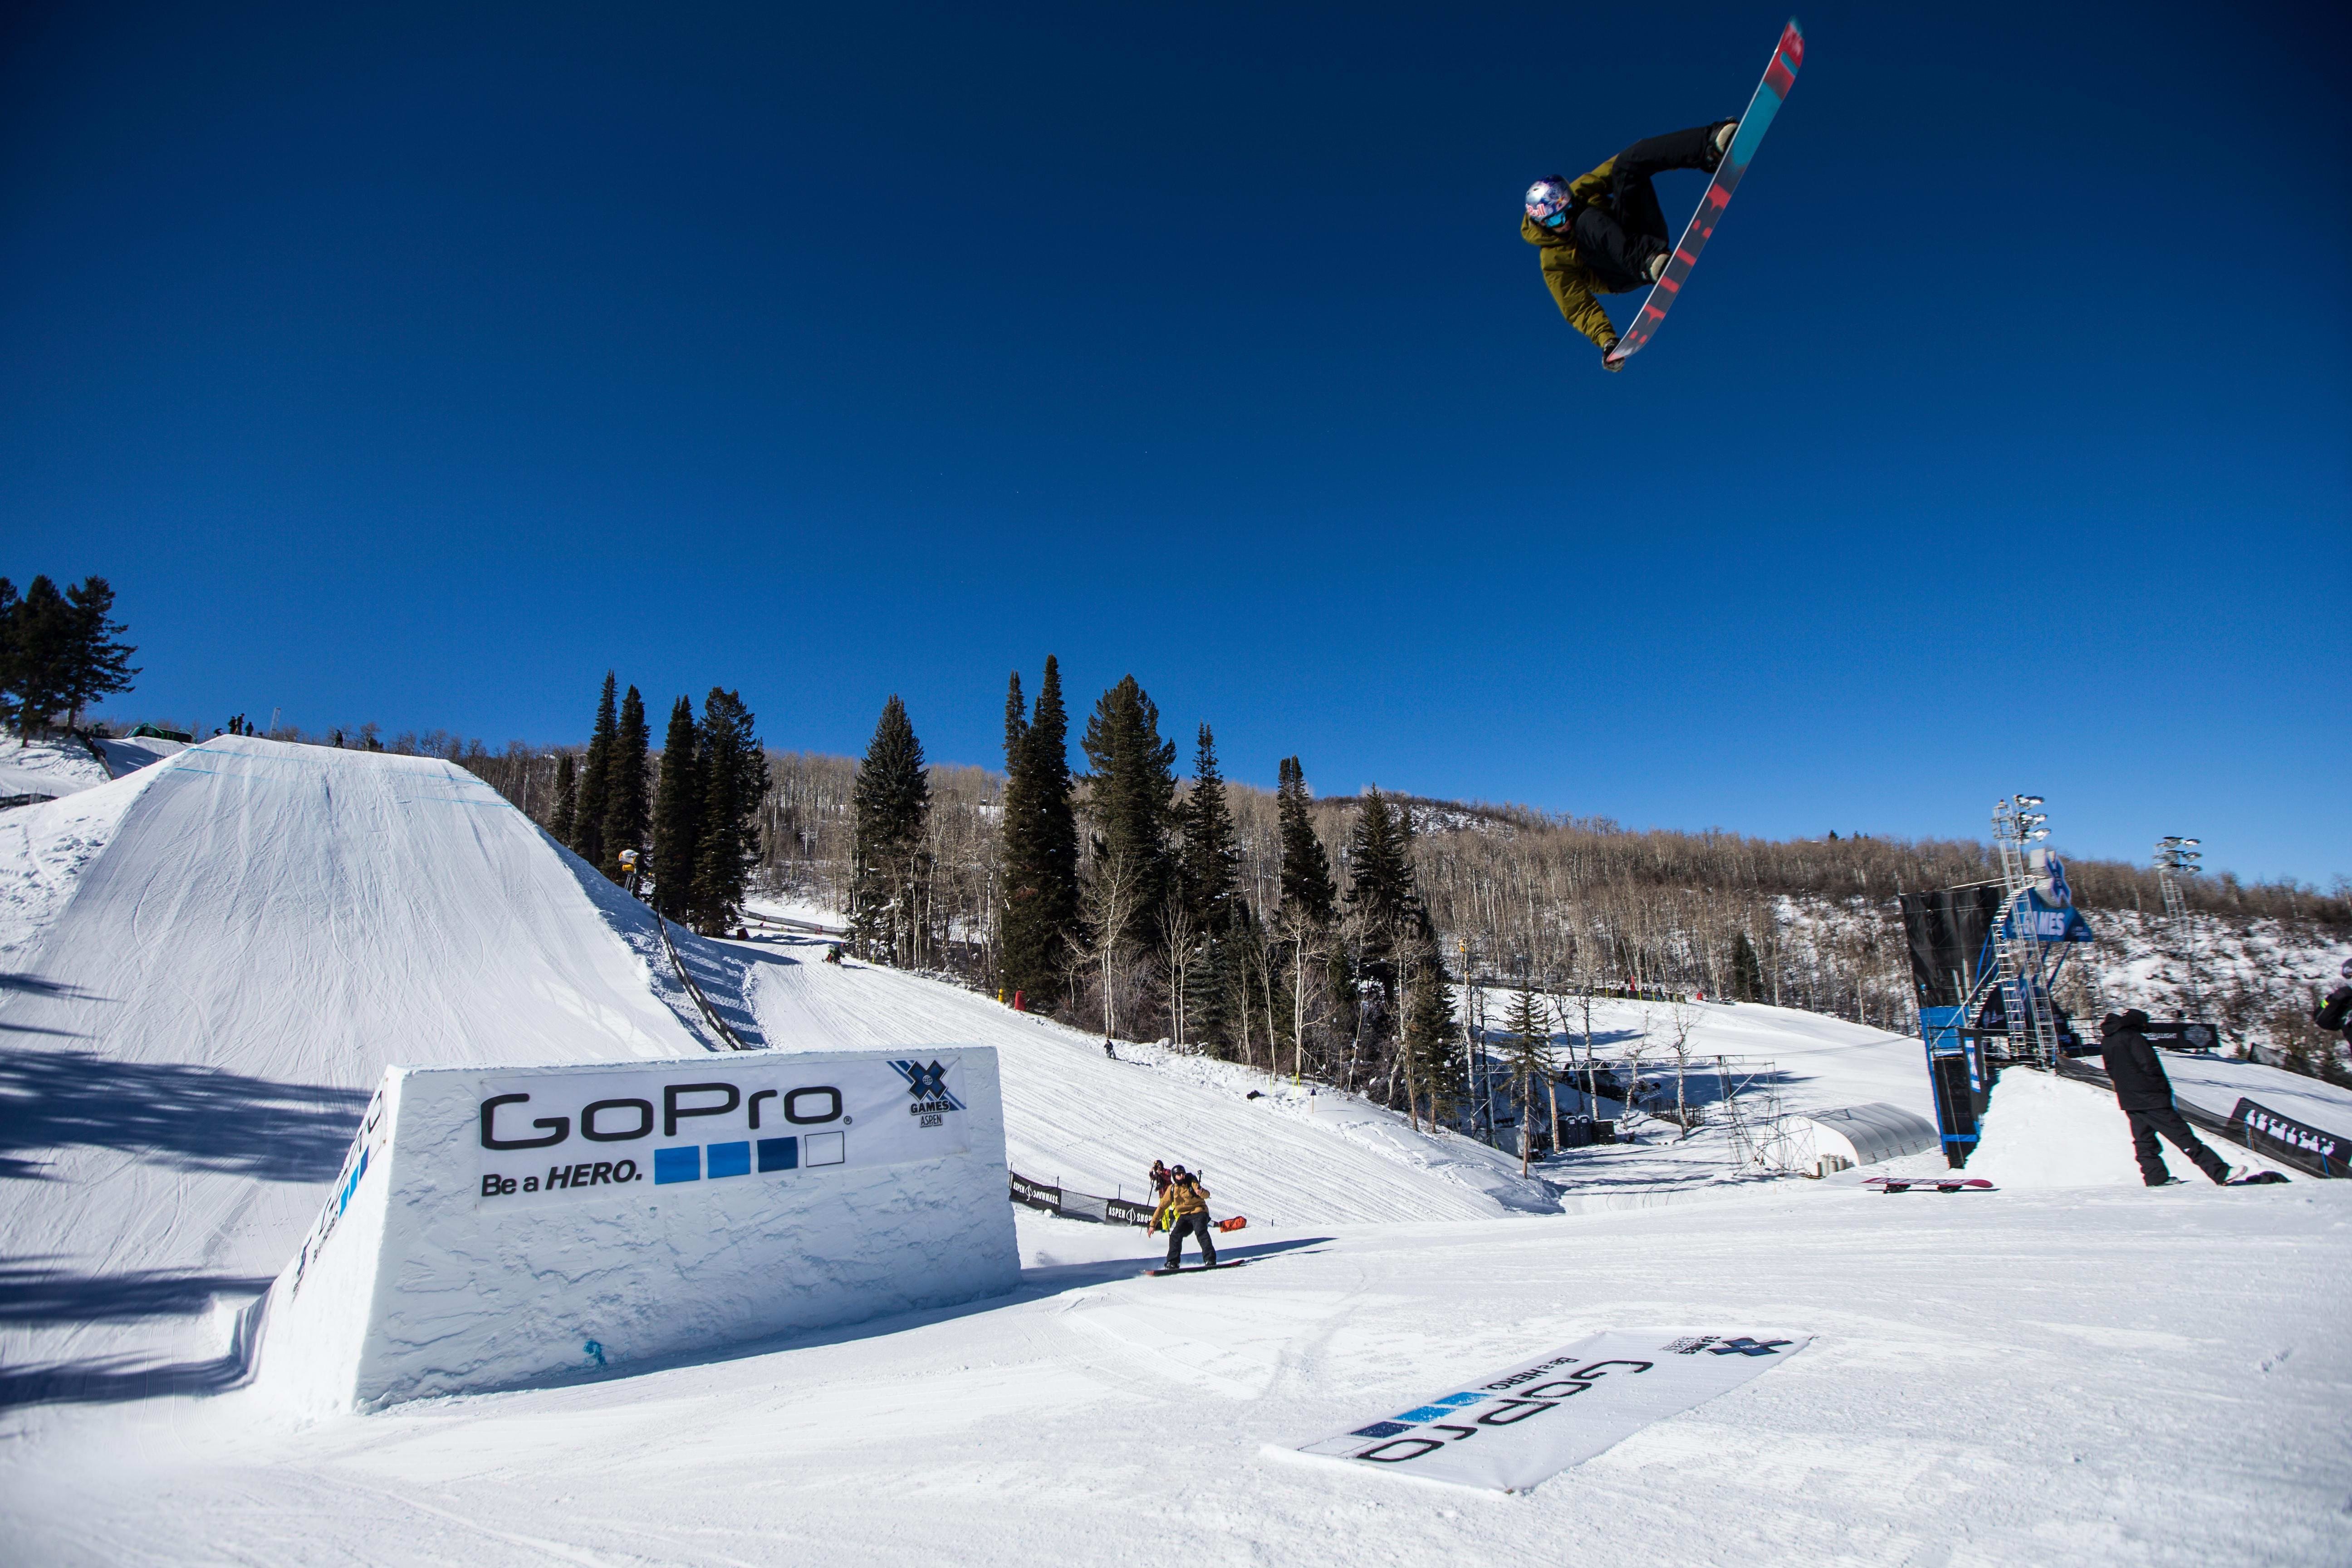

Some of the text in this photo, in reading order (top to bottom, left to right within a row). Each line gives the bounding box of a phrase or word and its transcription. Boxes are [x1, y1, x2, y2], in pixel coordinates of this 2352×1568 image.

[910, 1100, 950, 1113] GAMES
[480, 1083, 843, 1150] GoPro
[921, 1114, 942, 1126] ASPEN
[481, 1159, 642, 1196] Be a HERO.
[1013, 1181, 1025, 1194] ASPEN
[1108, 1206, 1126, 1219] ASPEN
[1678, 1336, 1721, 1354] GAMES
[1549, 1357, 1580, 1365] Be
[1480, 1369, 1549, 1390] HERO.
[1356, 1360, 1653, 1462] GoPro
